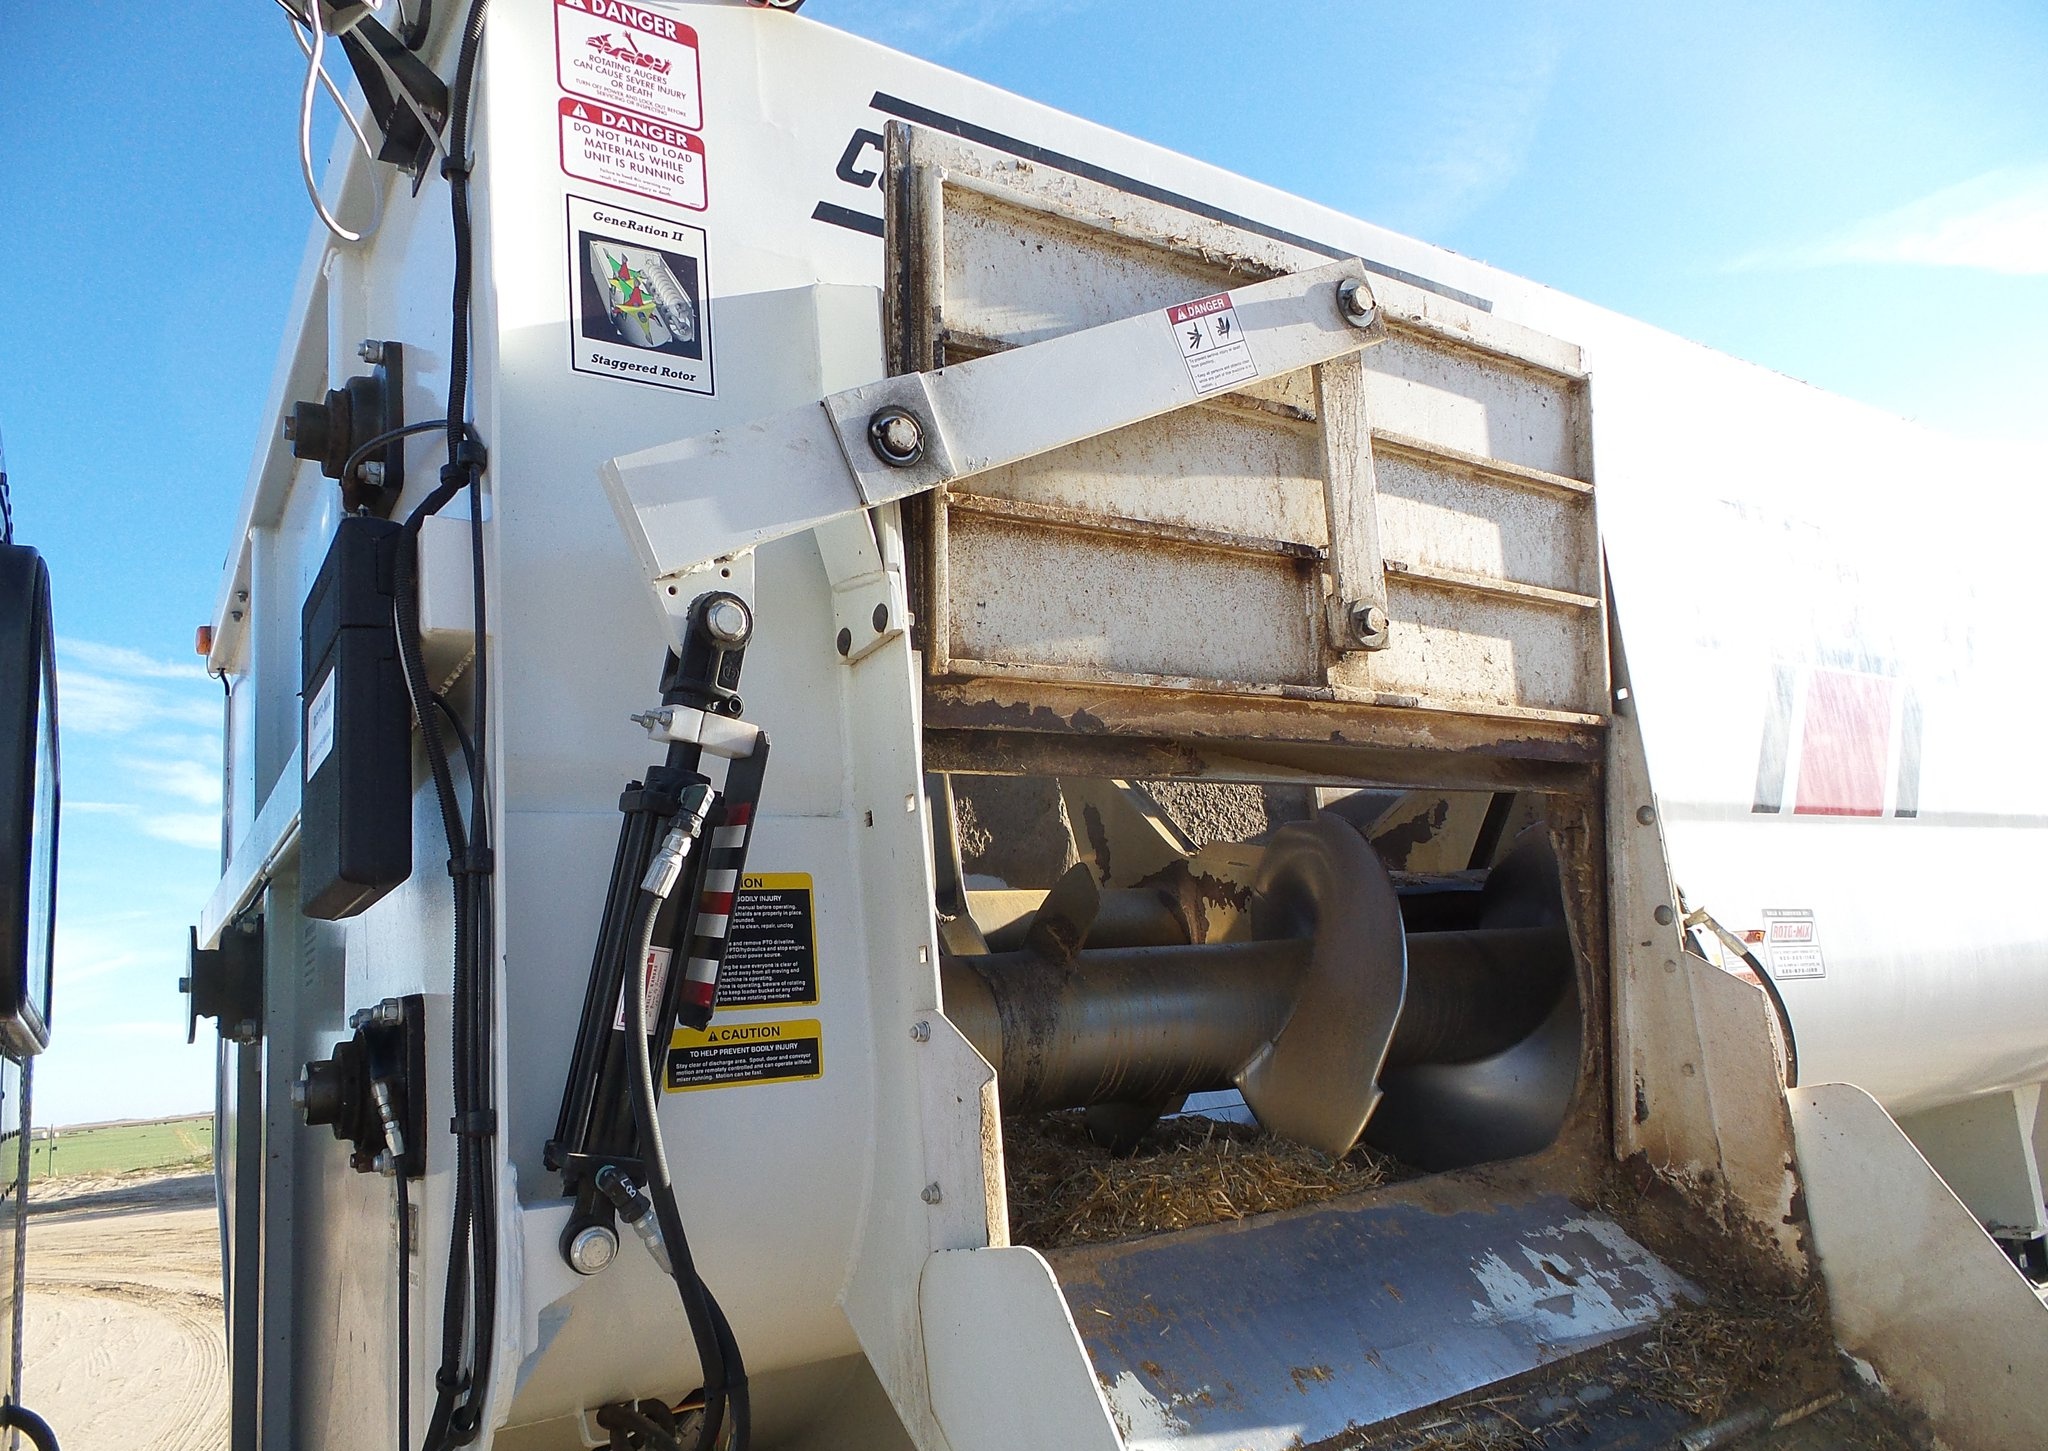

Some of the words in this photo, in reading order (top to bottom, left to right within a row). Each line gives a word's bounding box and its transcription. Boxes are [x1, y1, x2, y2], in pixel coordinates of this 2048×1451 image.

[592, 0, 677, 40] DANGER
[574, 59, 592, 70] CAN
[596, 66, 622, 80] CAUSE
[626, 76, 654, 90] SEVERE
[658, 85, 686, 100] INJURY
[589, 54, 630, 73] ROTATING
[634, 69, 667, 84] AUGERS
[576, 78, 590, 86] TURN
[604, 87, 624, 96] POWER
[638, 97, 652, 106] LOCK
[667, 107, 686, 117] BEFORE
[597, 90, 624, 102] SERVICING
[636, 102, 668, 116] INSPECTING
[610, 80, 623, 89] OR
[626, 84, 652, 98] DEATH
[574, 122, 591, 134] DO
[596, 128, 620, 142] NOT
[624, 136, 658, 153] HAND
[662, 147, 692, 162] LOAD
[601, 110, 688, 148] DANGER
[584, 138, 645, 161] MATERIALS
[649, 156, 684, 172] WHILE
[584, 150, 611, 164] UNIT
[616, 158, 626, 168] IS
[630, 162, 685, 185] RUNNING
[593, 211, 669, 238] GeneRation
[672, 231, 684, 242] II
[1188, 298, 1225, 317] DANGER
[591, 353, 657, 375] Staggered
[660, 367, 696, 382] Rotor
[721, 1026, 780, 1041] CAUTION
[720, 1047, 750, 1055] PREVENT
[751, 1045, 774, 1053] BODILY
